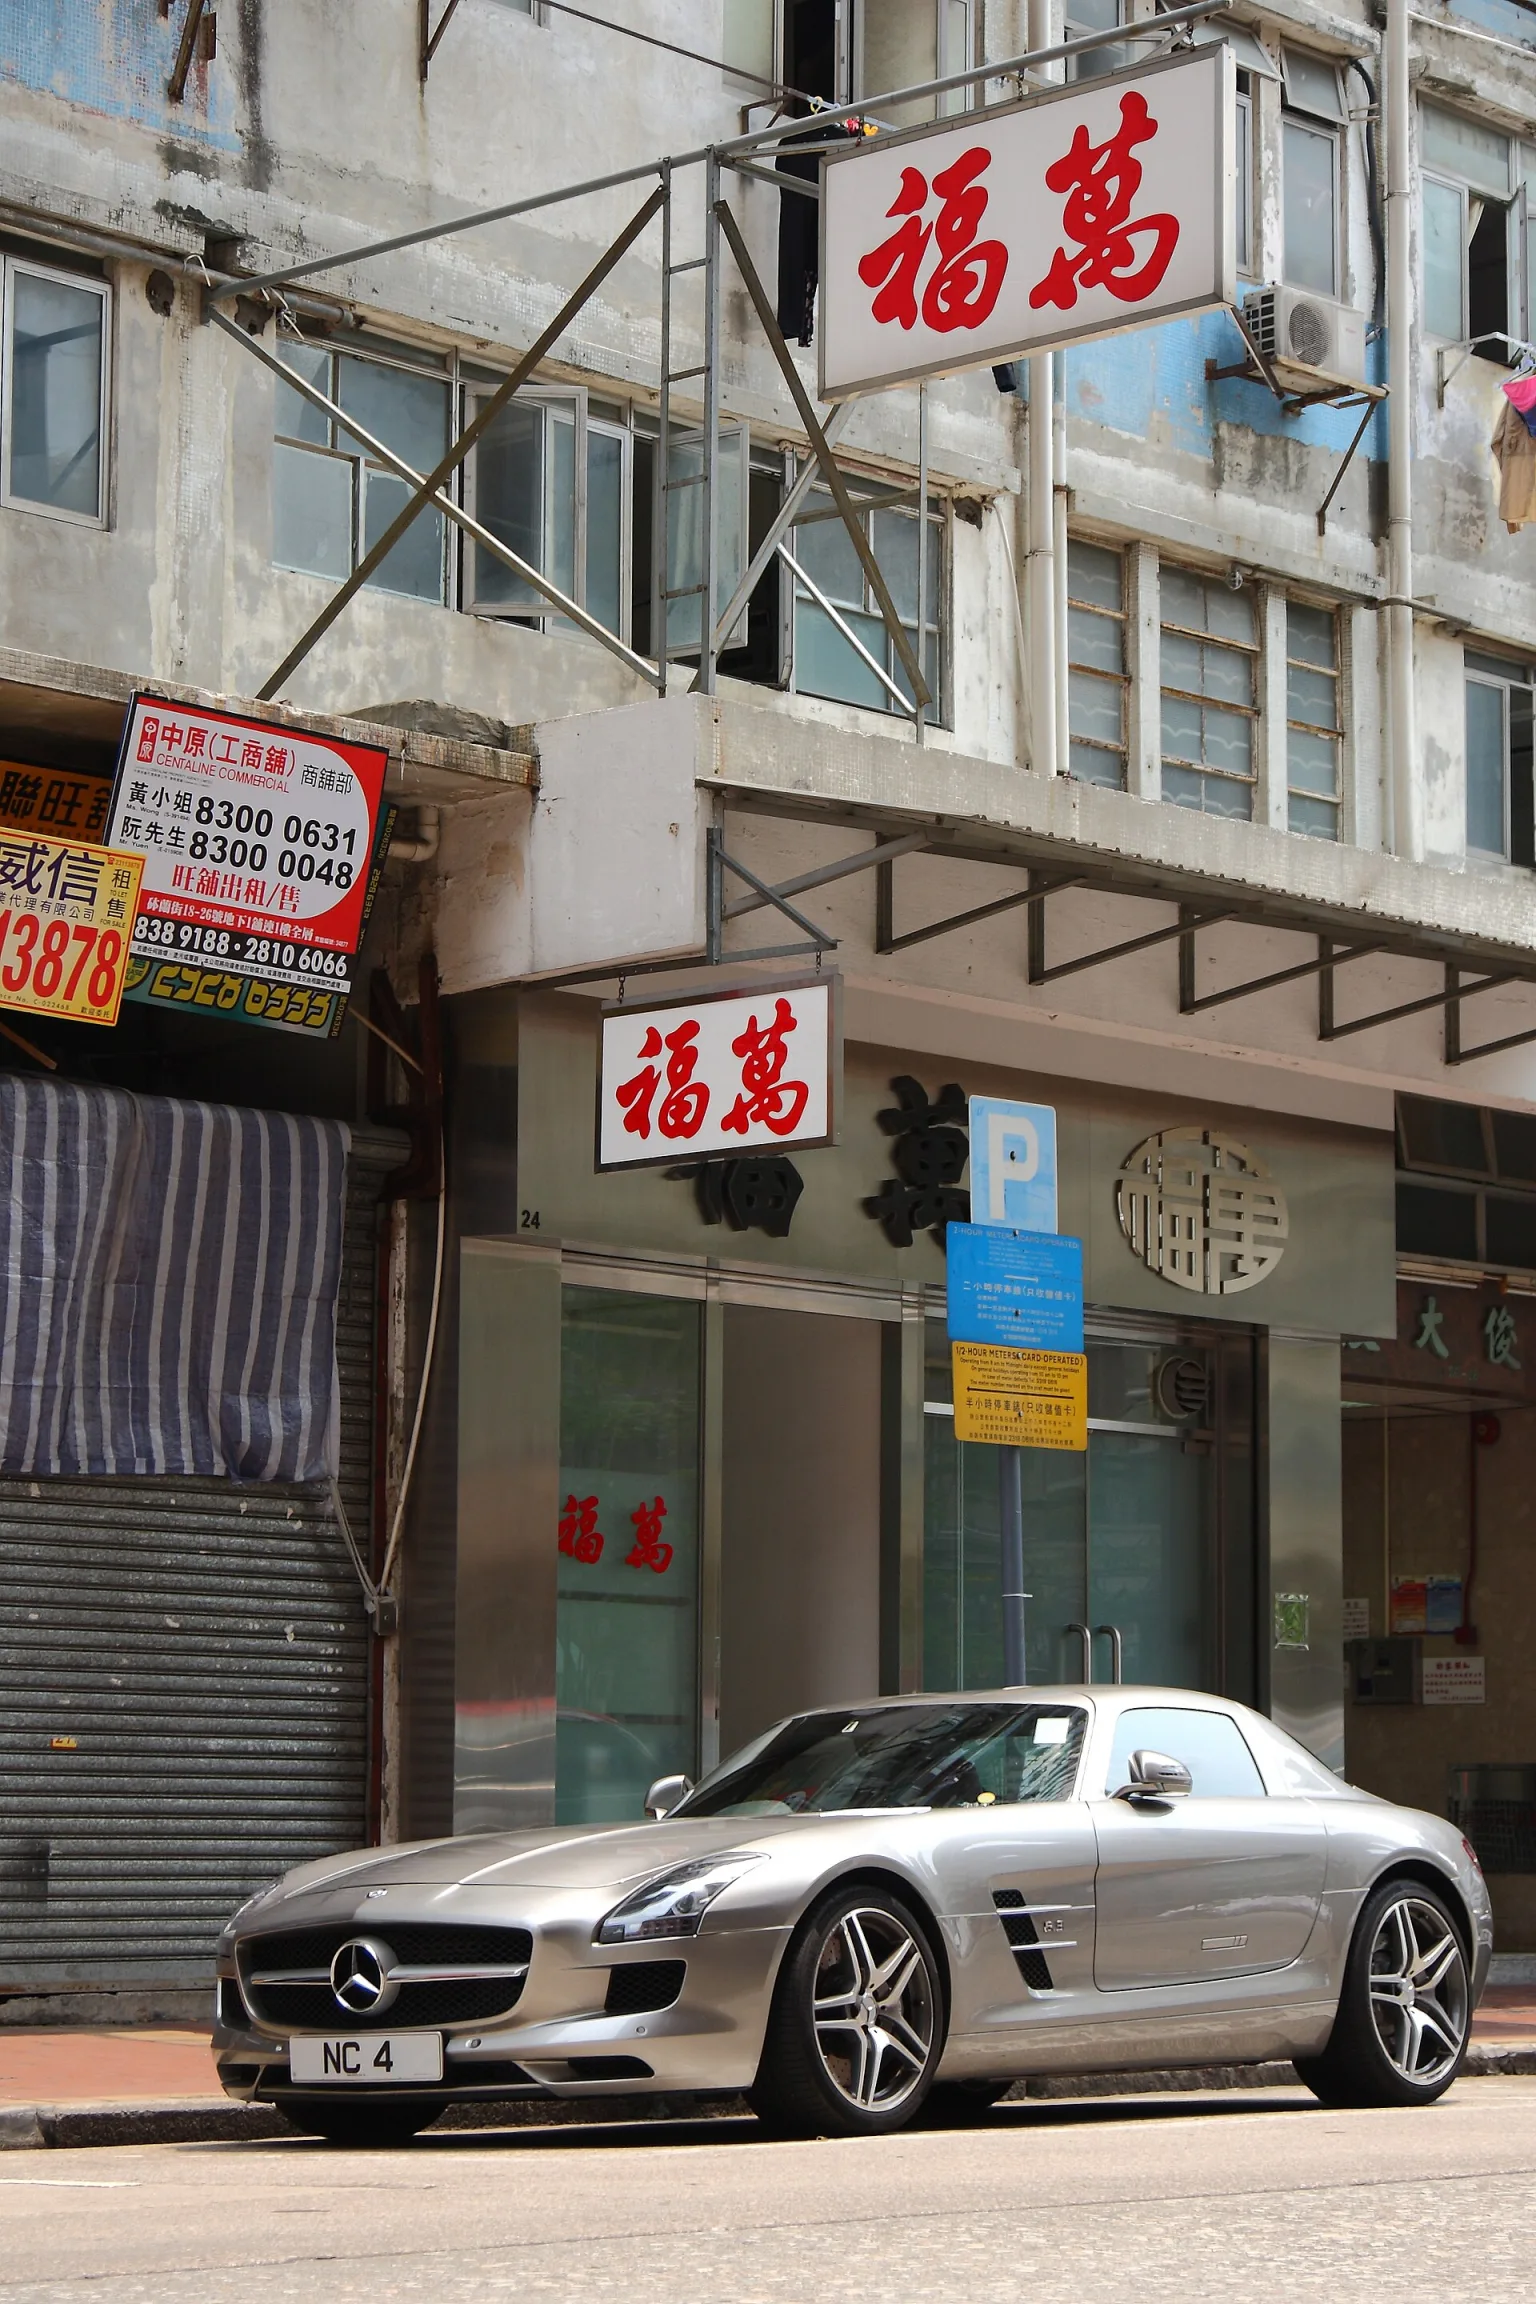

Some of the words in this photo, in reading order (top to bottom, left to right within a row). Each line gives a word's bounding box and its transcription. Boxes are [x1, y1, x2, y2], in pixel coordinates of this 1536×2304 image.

[160, 722, 296, 777] 中原(工商舖)
[156, 753, 217, 777] CENTALINE
[219, 767, 290, 793] COMMERCIAL
[301, 764, 354, 795] 商舖部
[129, 781, 194, 815] 黃小姐
[195, 796, 273, 837] 8300
[284, 815, 357, 855] 0631
[140, 807, 160, 816] Wong
[120, 815, 186, 849] 阮先生
[189, 831, 268, 872] 8300
[278, 850, 353, 890] 0048
[131, 841, 149, 849] Yuen
[0, 842, 105, 907] 威信
[112, 868, 131, 890] 租
[110, 889, 119, 897] TO
[120, 890, 128, 898] LET
[107, 898, 127, 919] 售
[100, 918, 111, 926] FOR
[111, 920, 127, 929] SALE
[179, 921, 230, 955] 9188
[244, 937, 295, 966] 2810
[298, 947, 347, 977] 6066
[988, 1112, 1039, 1221] P
[521, 1210, 541, 1230] 24
[954, 1226, 983, 1237] 2-HOUR
[986, 1230, 1015, 1241] METERS
[956, 1346, 987, 1357] 1/2-HOUR
[989, 1349, 1016, 1360] METERS
[323, 2041, 361, 2075] NC
[373, 2040, 393, 2073] 4
